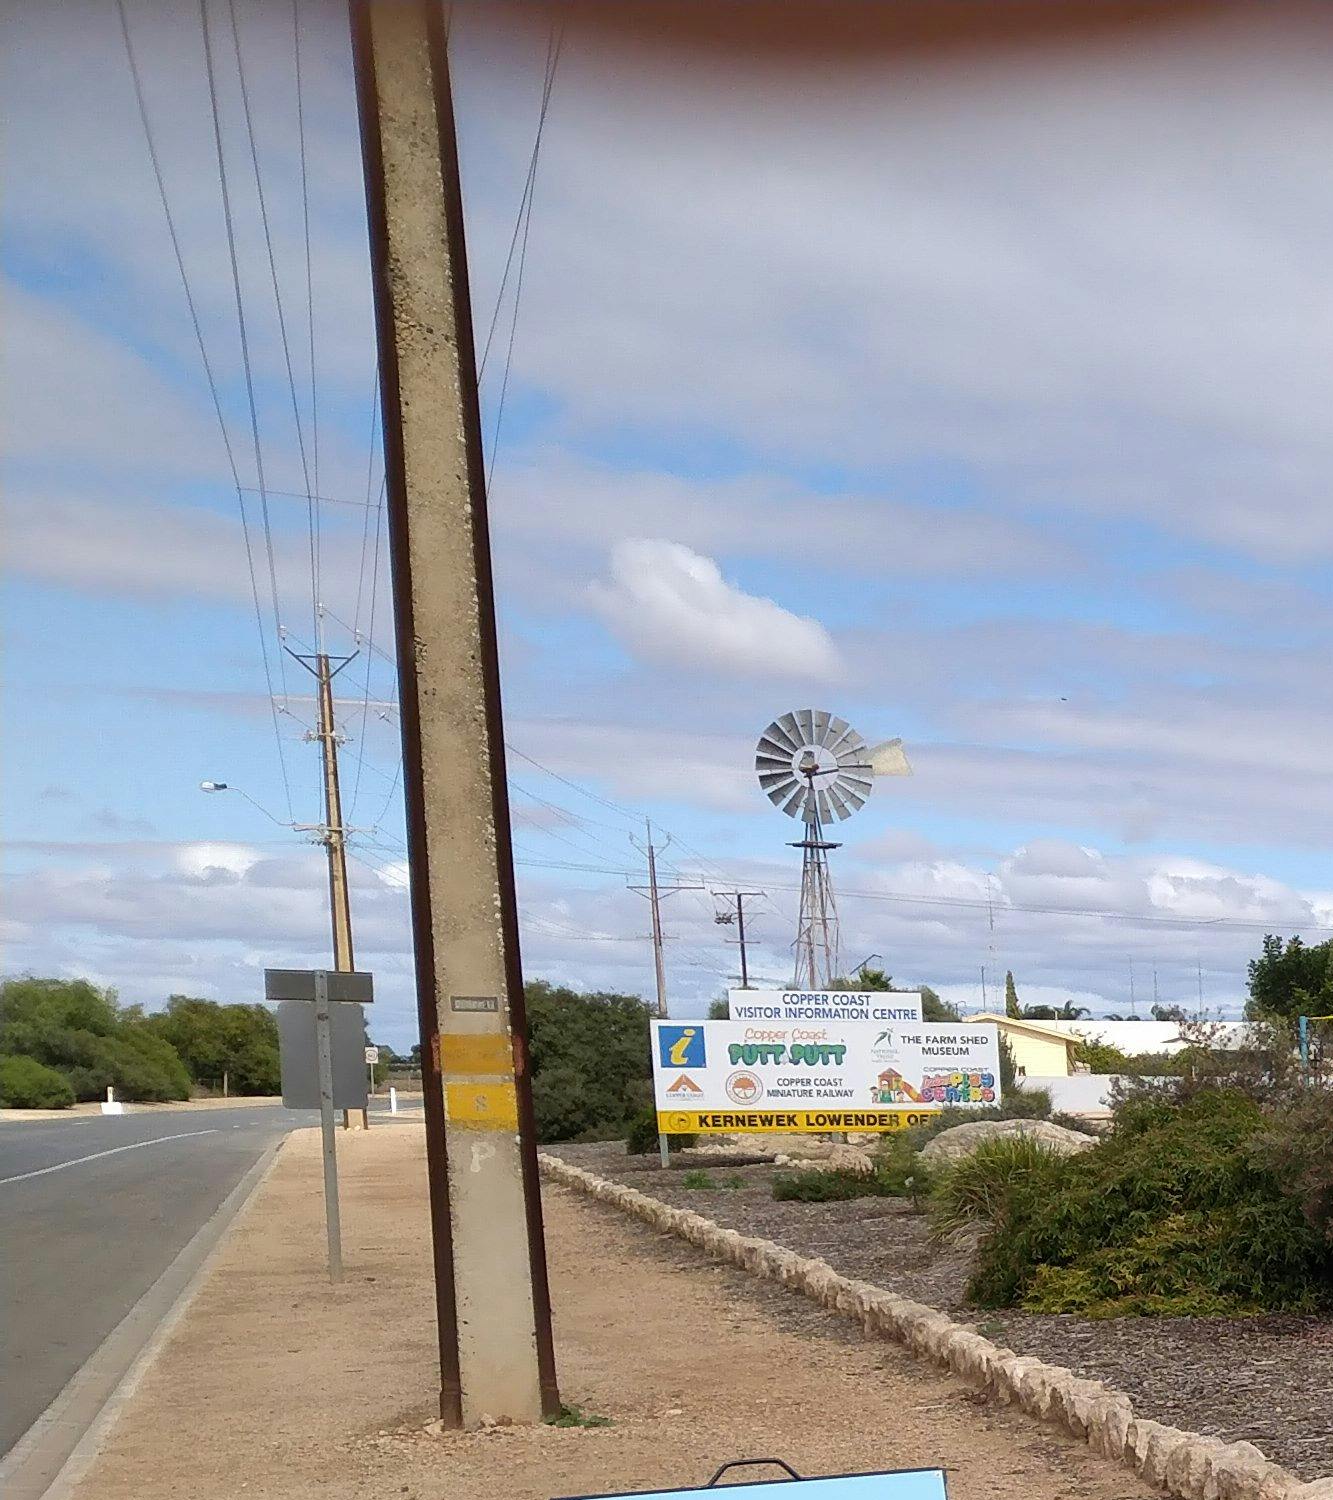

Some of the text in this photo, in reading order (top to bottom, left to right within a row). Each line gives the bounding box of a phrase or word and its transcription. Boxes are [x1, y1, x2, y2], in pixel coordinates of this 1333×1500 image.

[782, 993, 871, 1007] COPPER COAST
[735, 1006, 918, 1021] VISITOR INFORMATION CENTRE
[745, 1027, 828, 1041] Copper Coast
[901, 1035, 989, 1045] THE FARM SHED
[727, 1043, 786, 1066] PUTT
[790, 1043, 847, 1066] PUTT
[921, 1046, 970, 1056] MUSEUM
[776, 1078, 843, 1087] COPPER COAST
[766, 1089, 855, 1098] MINIATURE RAILWAY
[698, 1113, 799, 1128] KERNEWEK
[805, 1113, 899, 1127] LOWENDER
